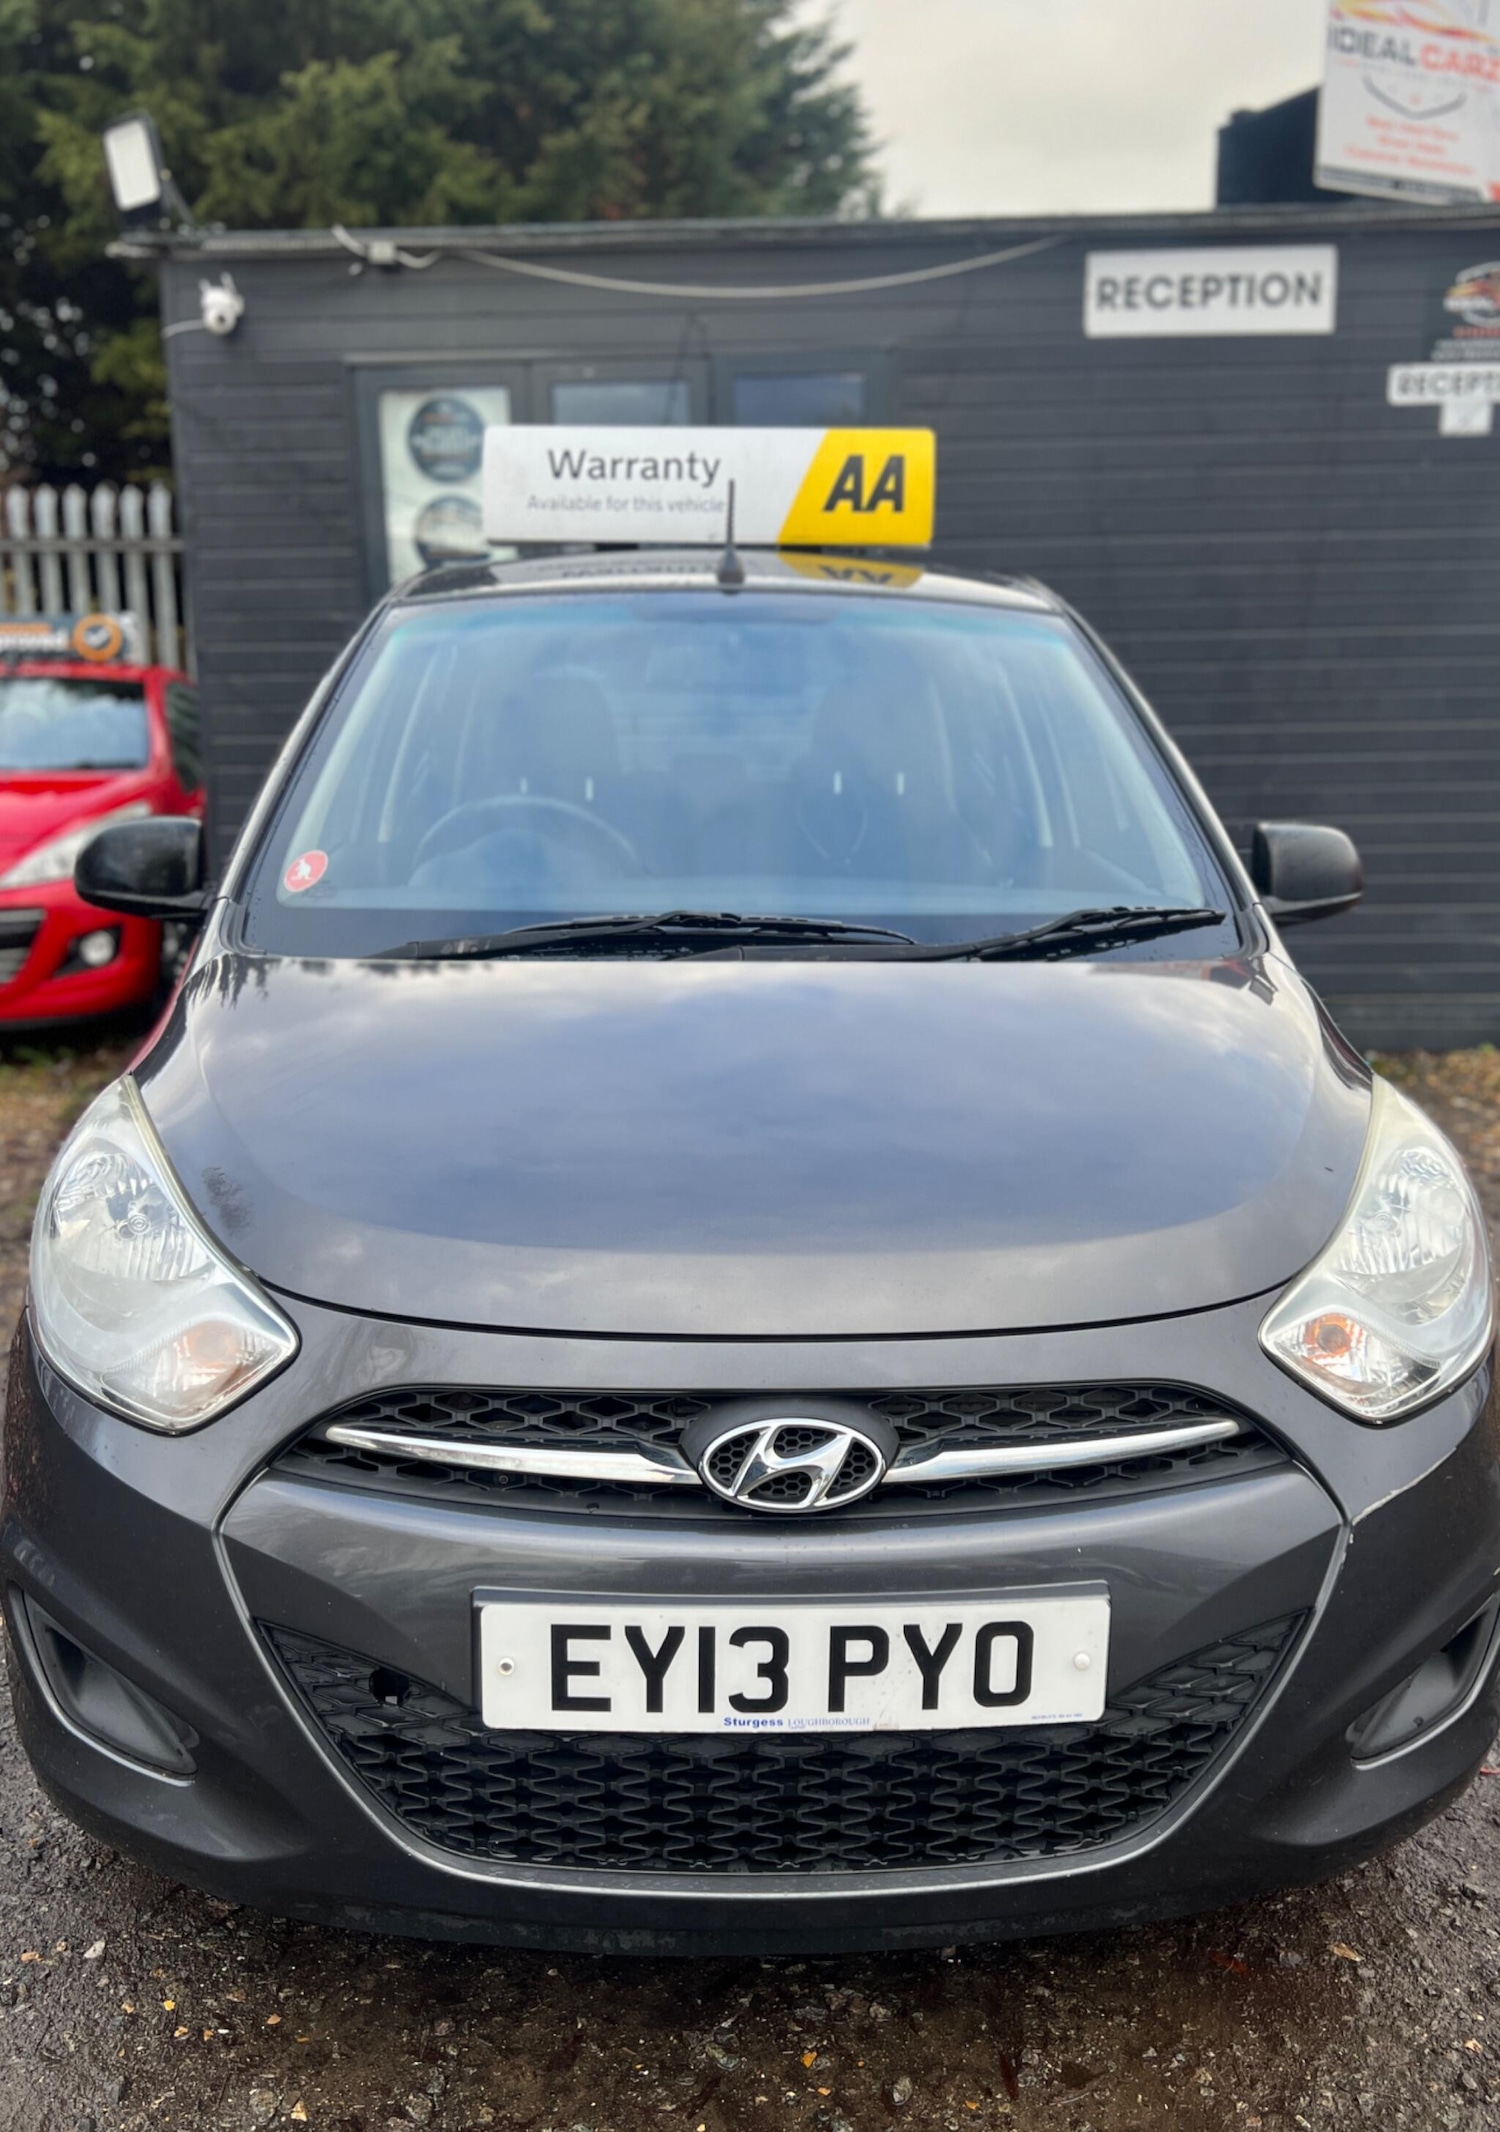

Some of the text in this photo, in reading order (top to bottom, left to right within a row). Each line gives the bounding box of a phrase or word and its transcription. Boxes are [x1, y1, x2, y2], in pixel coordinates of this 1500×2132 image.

[1327, 24, 1417, 66] IDEAL
[1096, 273, 1322, 311] RECEPTION
[547, 449, 721, 487] Warranty
[822, 454, 906, 514] AA
[527, 494, 726, 513] Available for this vehicle
[550, 1619, 1035, 1714] EY13 PYO
[723, 1717, 870, 1728] Sturgess LOUGHBOROUGH
